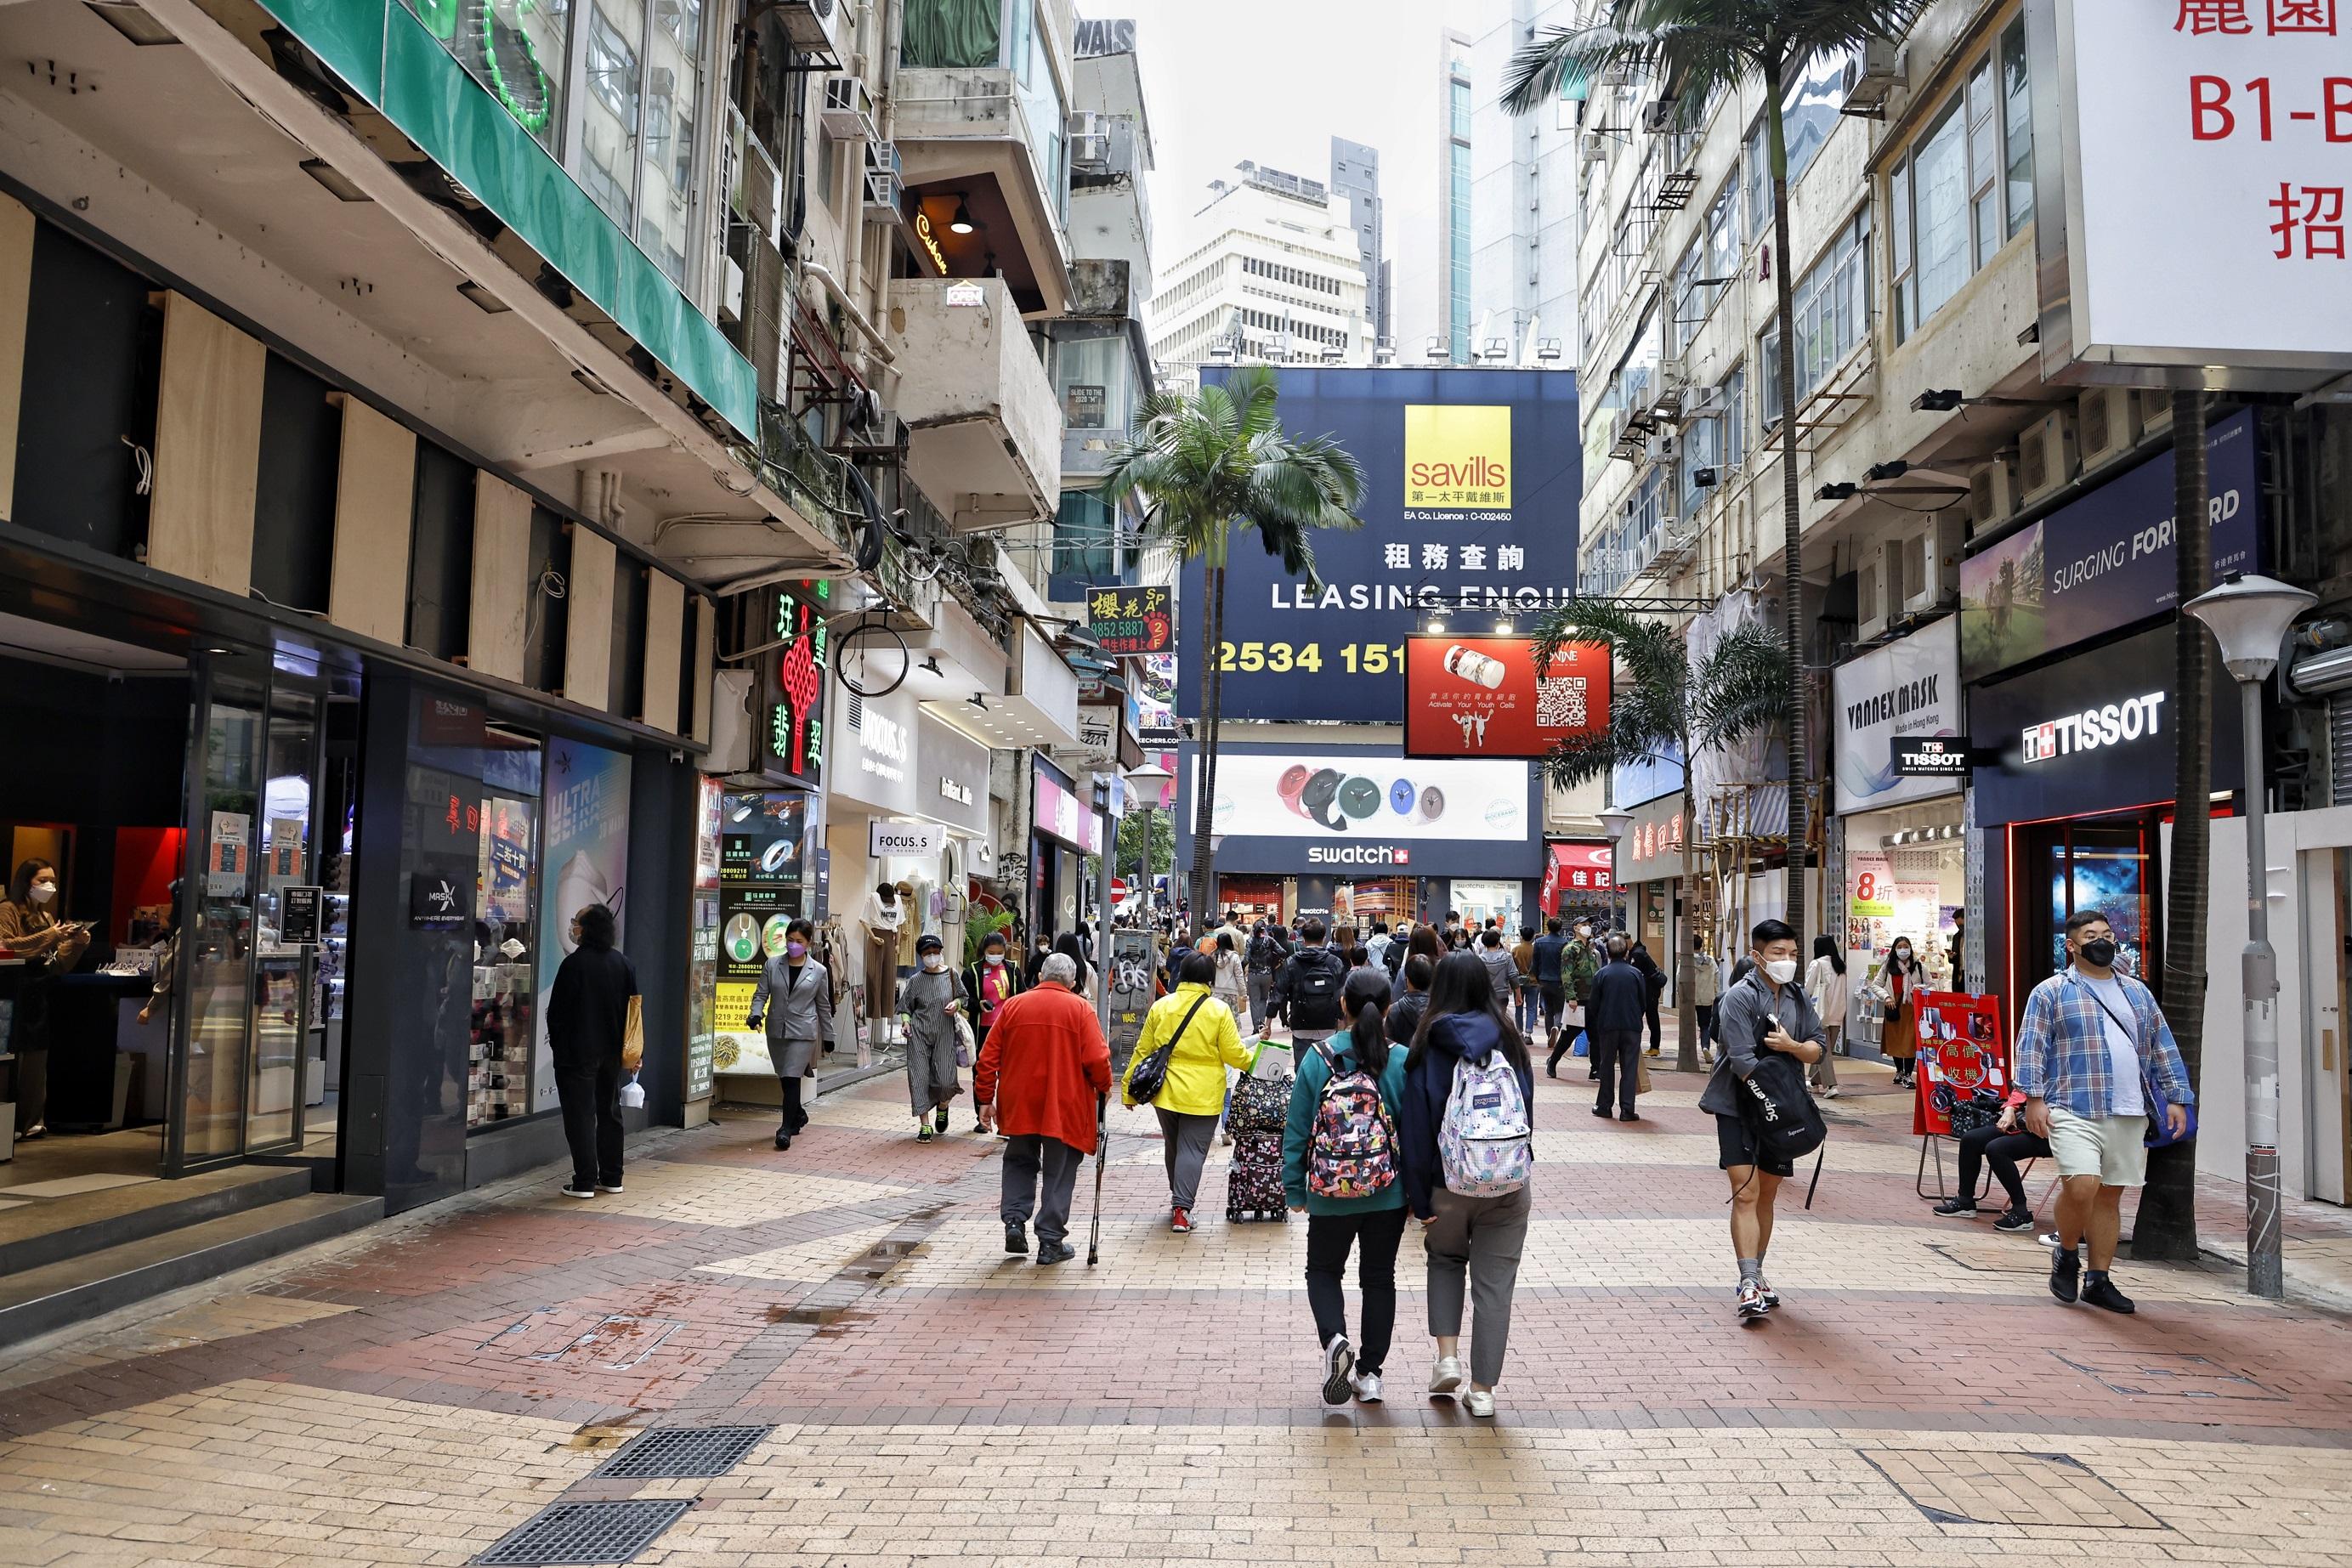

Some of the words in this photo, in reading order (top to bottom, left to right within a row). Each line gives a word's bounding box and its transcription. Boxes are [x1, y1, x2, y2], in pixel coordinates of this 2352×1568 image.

[1074, 20, 1135, 55] WAIS
[2190, 75, 2352, 143] B1-B
[2269, 182, 2345, 259] 招
[916, 212, 948, 275] Cuban
[949, 290, 980, 302] OPEN
[1411, 456, 1505, 488] savills
[1411, 490, 1505, 503] 第一太平戴維斯
[1403, 511, 1416, 520] EA
[1418, 512, 1432, 520] Co.
[1471, 512, 1511, 522] C-002450
[2053, 541, 2126, 594] SURGING
[2132, 489, 2240, 561] FORRD
[1385, 542, 1524, 571] 租務查詢
[1091, 592, 1143, 620] 櫻花
[1271, 583, 1442, 611] LEASING
[1461, 586, 1579, 613] ENQU
[1091, 621, 1116, 637] 9852
[1119, 620, 1143, 637] 5887
[1210, 641, 1323, 674] 2534
[1847, 689, 1896, 733] VANNEX
[1898, 673, 1939, 716] MASK
[1895, 723, 1907, 735] Made
[1908, 721, 1913, 732] in
[1913, 717, 1926, 729] Hong
[1926, 714, 1939, 726] Kong
[2054, 691, 2165, 755] TISSOT
[1901, 753, 1964, 766] TISSOT
[700, 784, 722, 811] Nail
[700, 814, 719, 836] Box
[879, 836, 918, 846] FOCUS.
[1308, 845, 1393, 864] swatch
[1572, 869, 1610, 887] 佳記
[1856, 872, 1893, 901] 8折
[1121, 1013, 1136, 1023] WAIS
[1946, 1044, 1976, 1059] 高價
[1947, 1066, 1978, 1081] 收機
[1747, 1078, 1779, 1122] Supreme
[1788, 1127, 1805, 1136] Supreme
